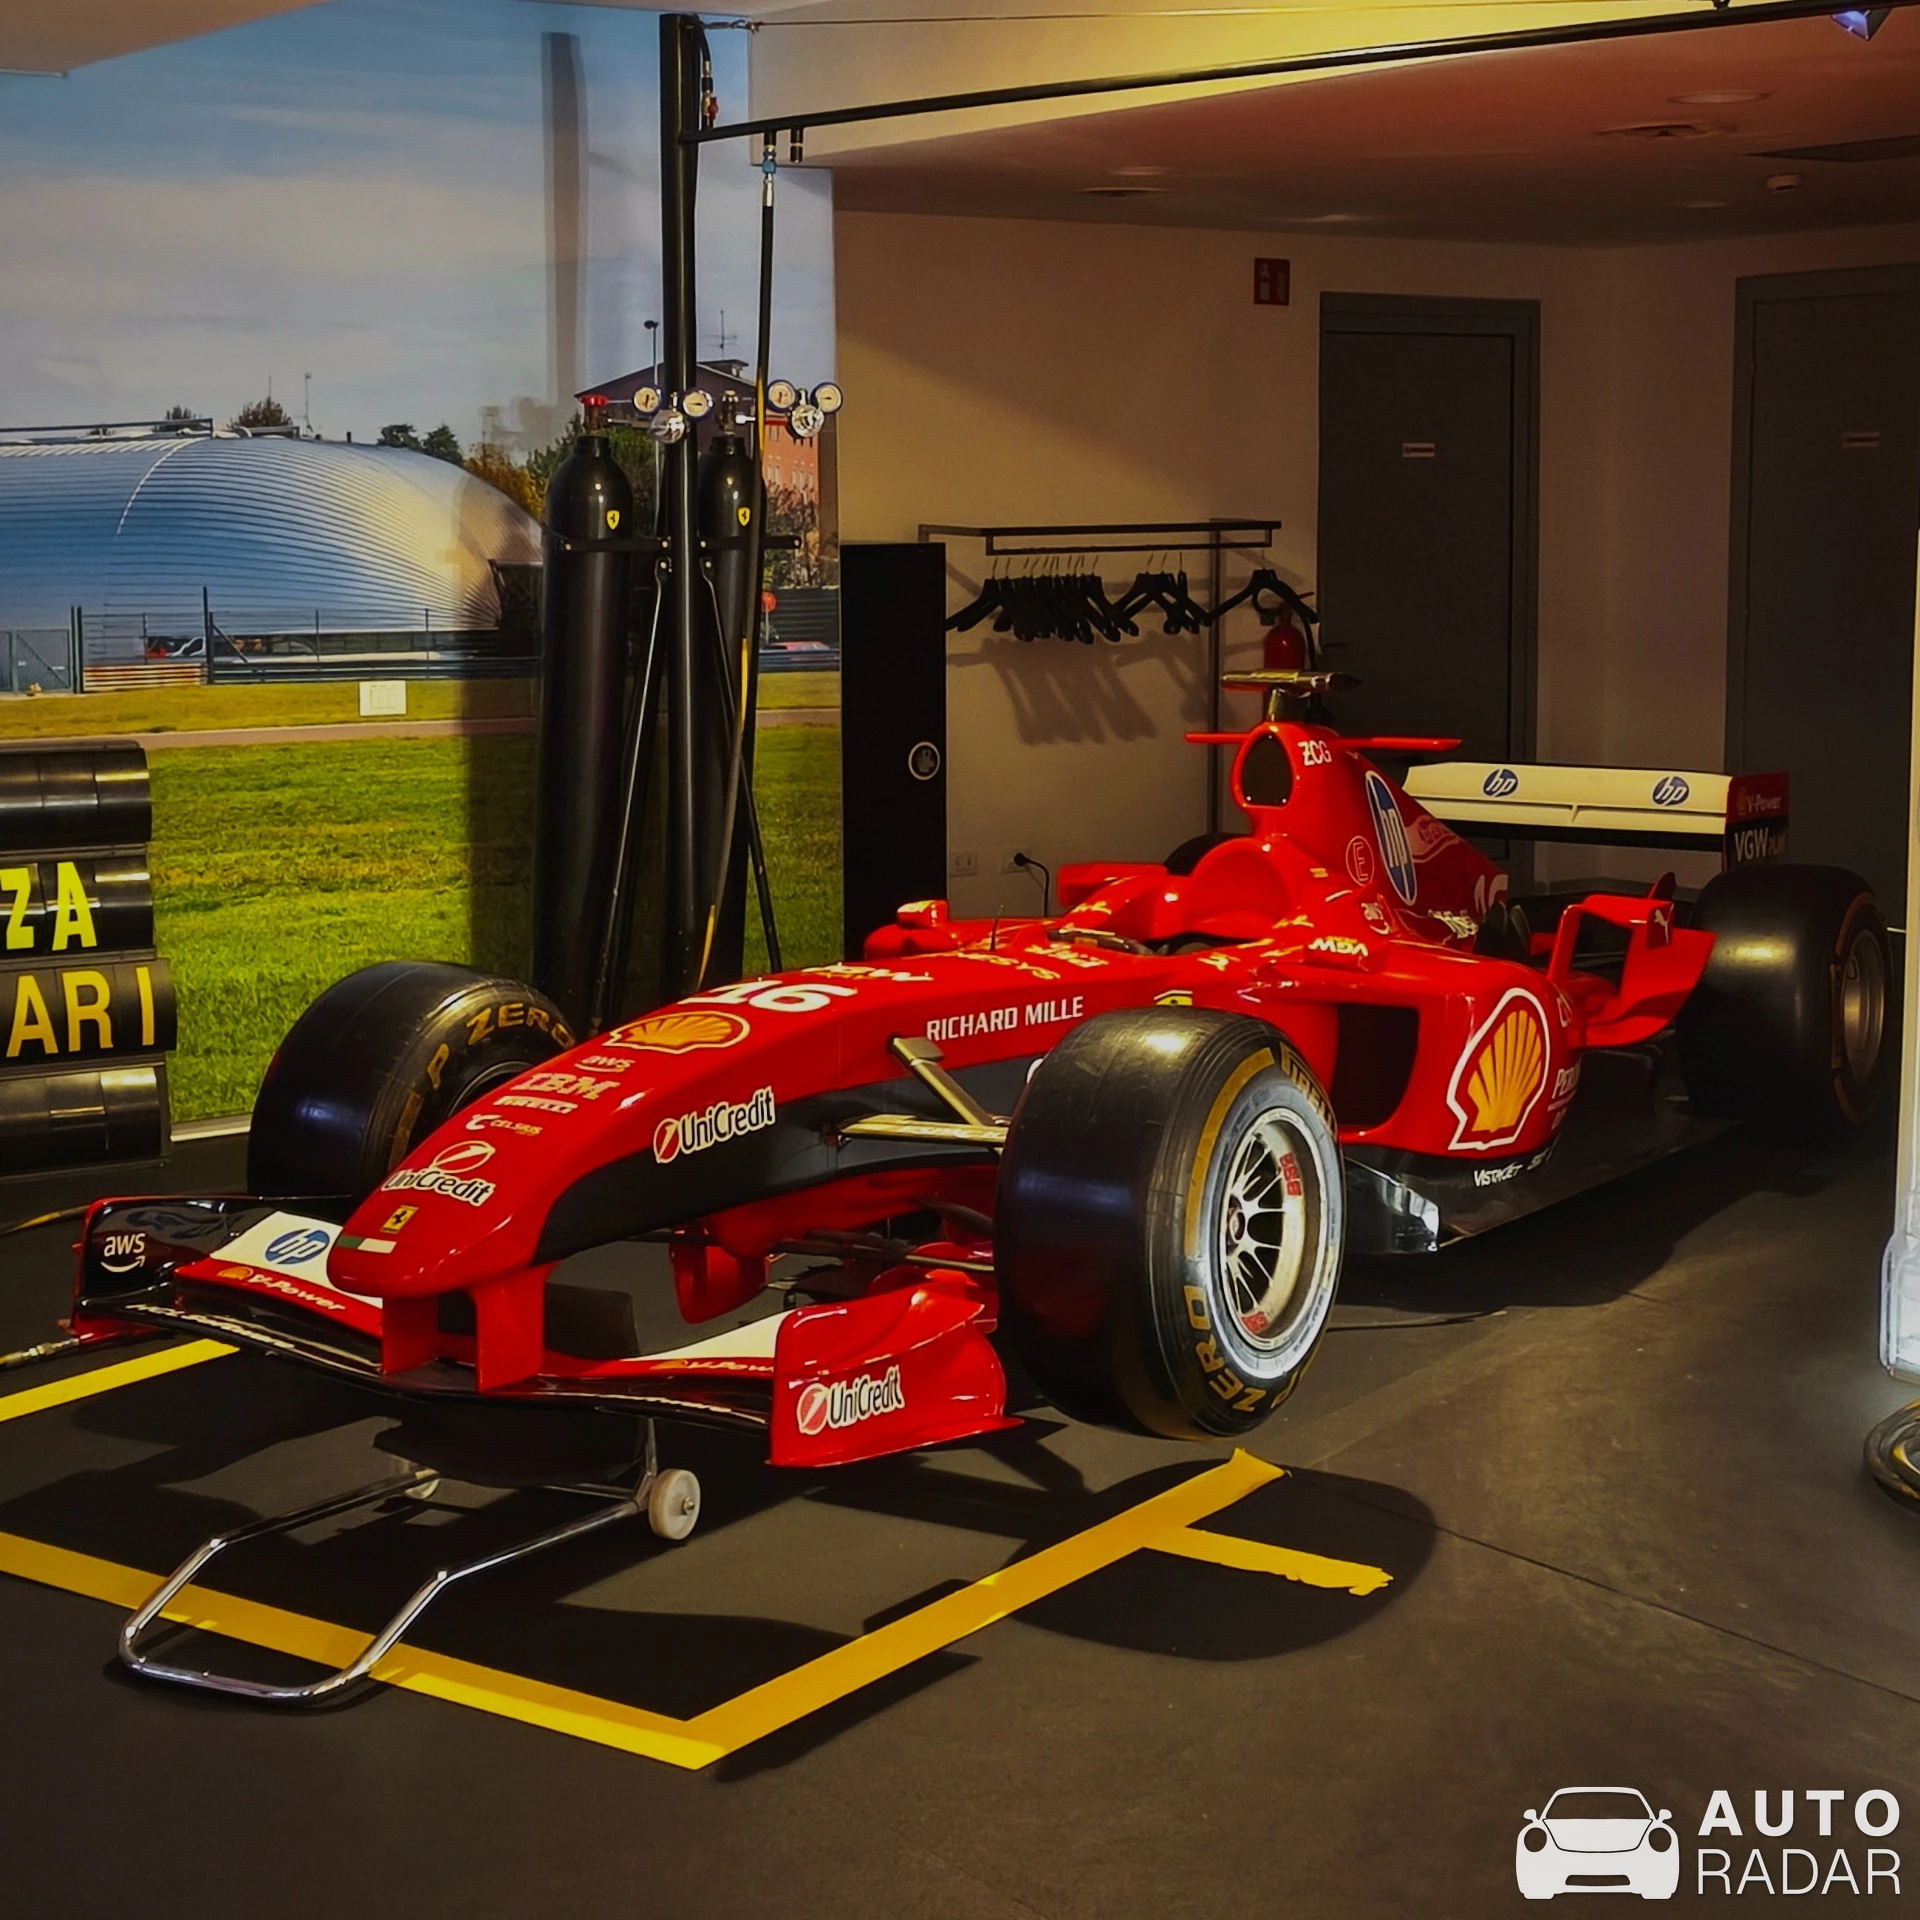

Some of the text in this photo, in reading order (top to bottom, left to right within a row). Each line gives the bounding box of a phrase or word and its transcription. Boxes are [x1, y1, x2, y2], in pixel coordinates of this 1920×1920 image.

[1298, 739, 1332, 767] ZCG
[1484, 769, 1518, 797] hp
[1653, 775, 1688, 806] hp
[1734, 826, 1770, 863] VGW
[0, 861, 98, 952] ZA
[6, 966, 155, 1058] ARI
[677, 979, 859, 1013] 16
[466, 1003, 577, 1050] ZERO
[926, 996, 1084, 1042] RICHARD MILLE
[510, 1072, 621, 1101] IBM
[679, 1086, 775, 1153] UniCredit
[384, 1168, 494, 1206] UniCredit
[103, 1232, 147, 1258] aws
[268, 1228, 328, 1265] hp
[248, 1273, 346, 1312] V-Power
[1184, 1285, 1267, 1412] ZERO
[828, 1365, 904, 1428] UniCredit
